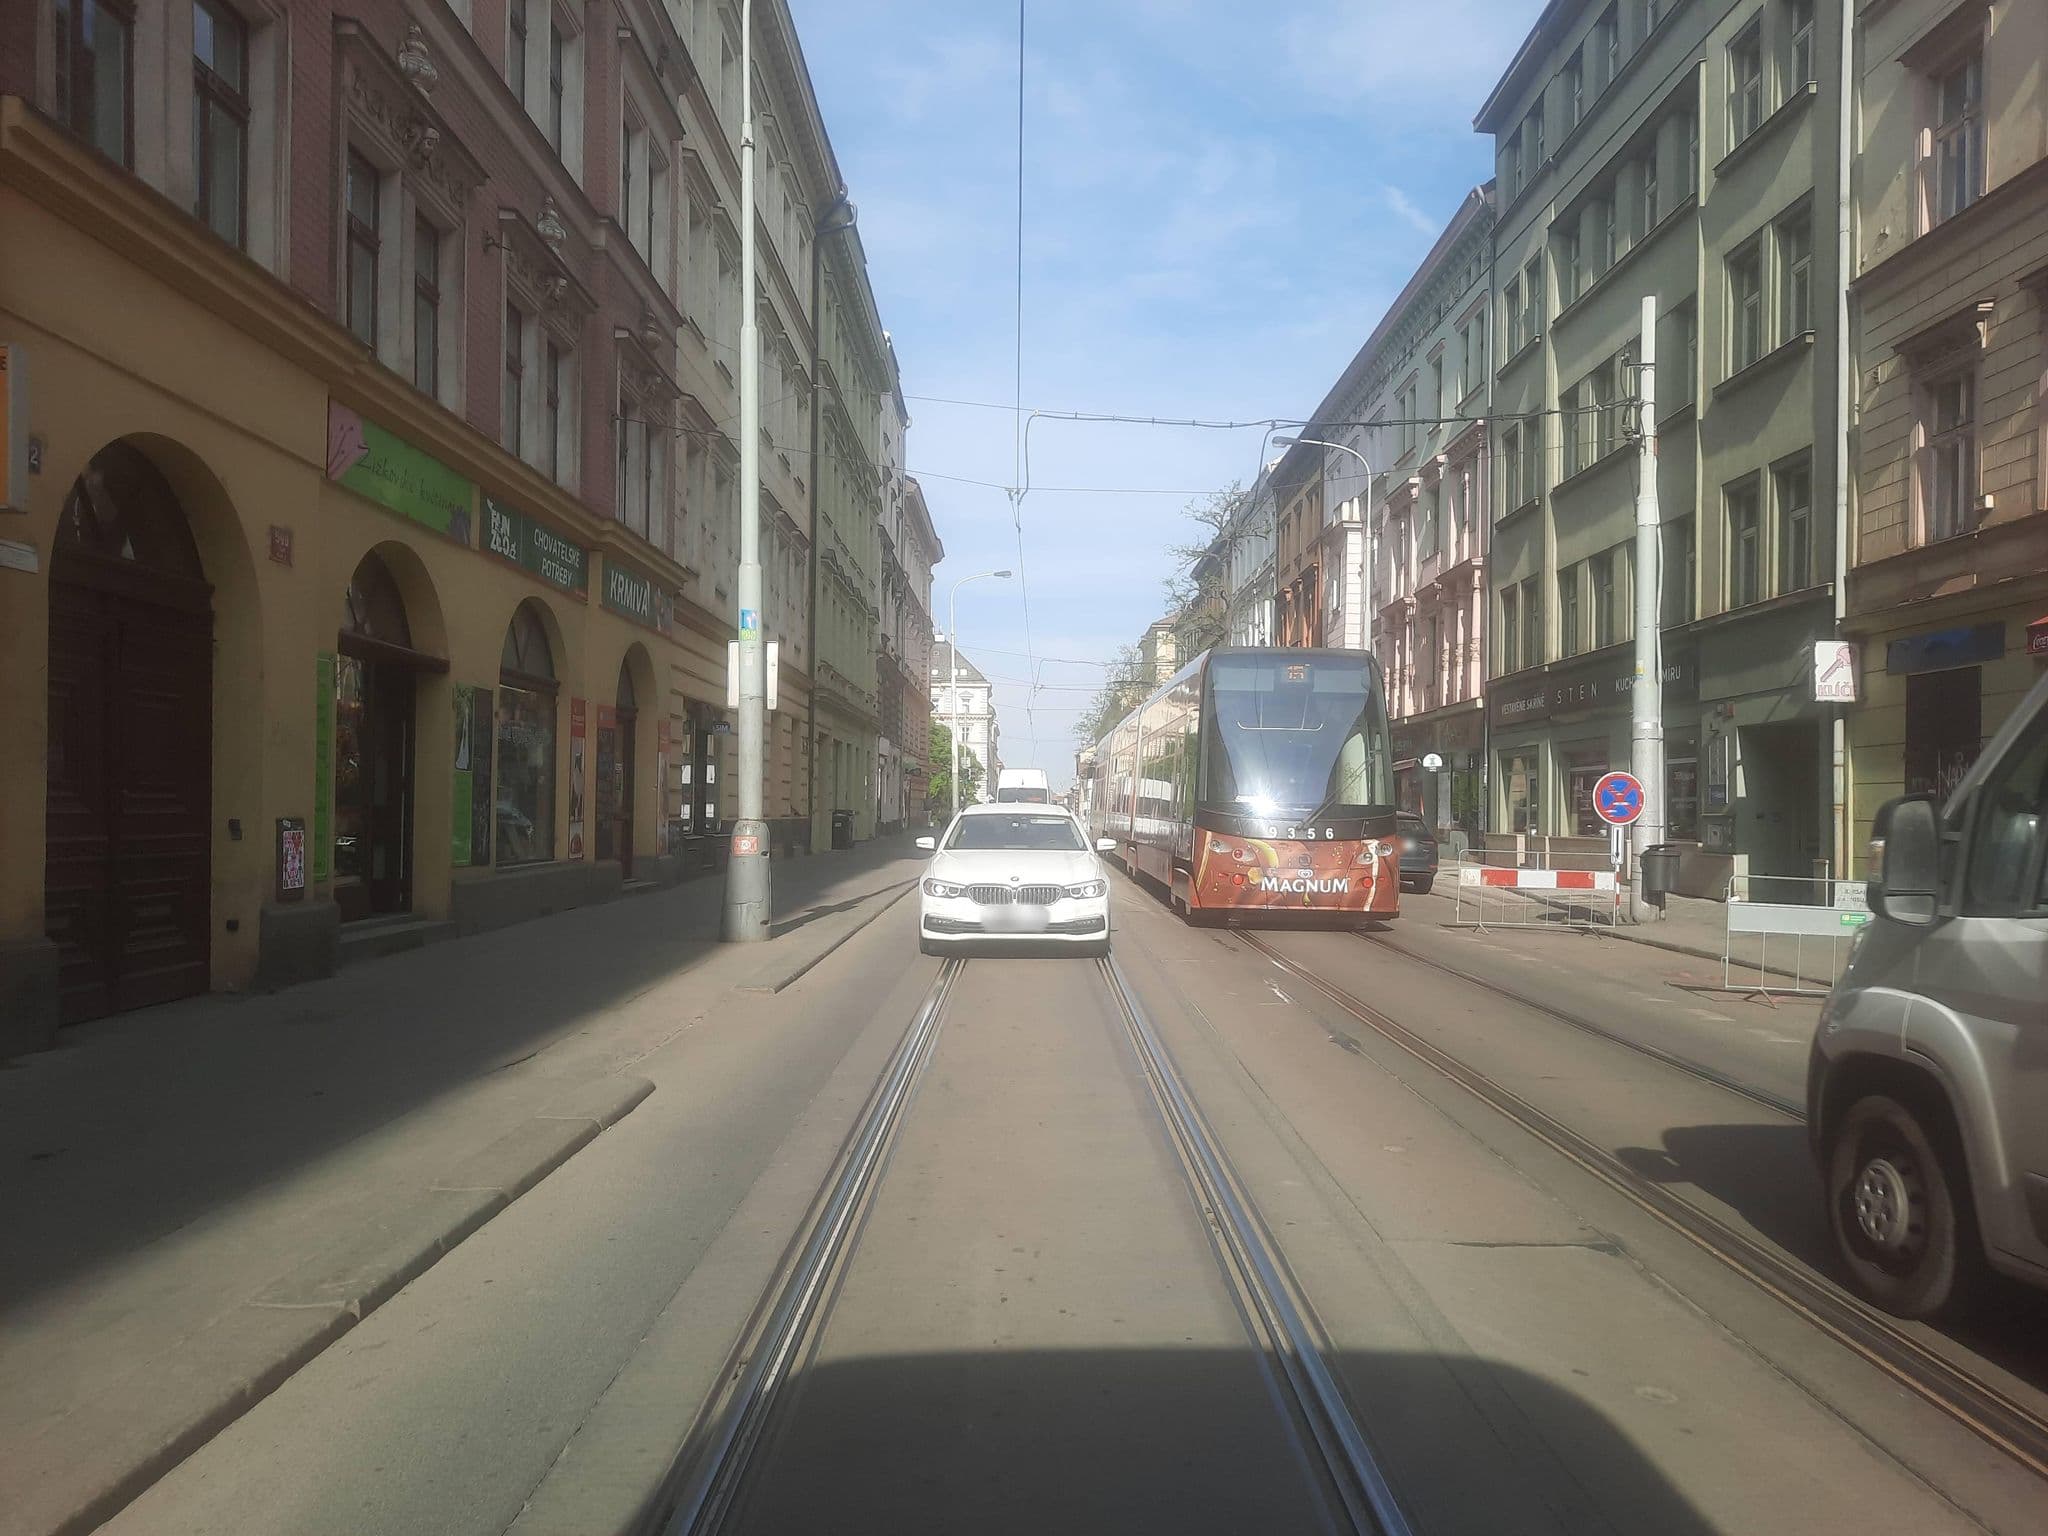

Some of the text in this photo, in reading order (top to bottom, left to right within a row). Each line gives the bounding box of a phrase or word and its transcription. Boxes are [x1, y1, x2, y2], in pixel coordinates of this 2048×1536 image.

[541, 557, 573, 587] POTŘEBY
[610, 569, 650, 617] KRMIVA
[1557, 682, 1597, 704] STEN
[1615, 676, 1635, 693] KUCH
[1268, 826, 1334, 840] 9356
[1261, 876, 1348, 893] MAGNUM
